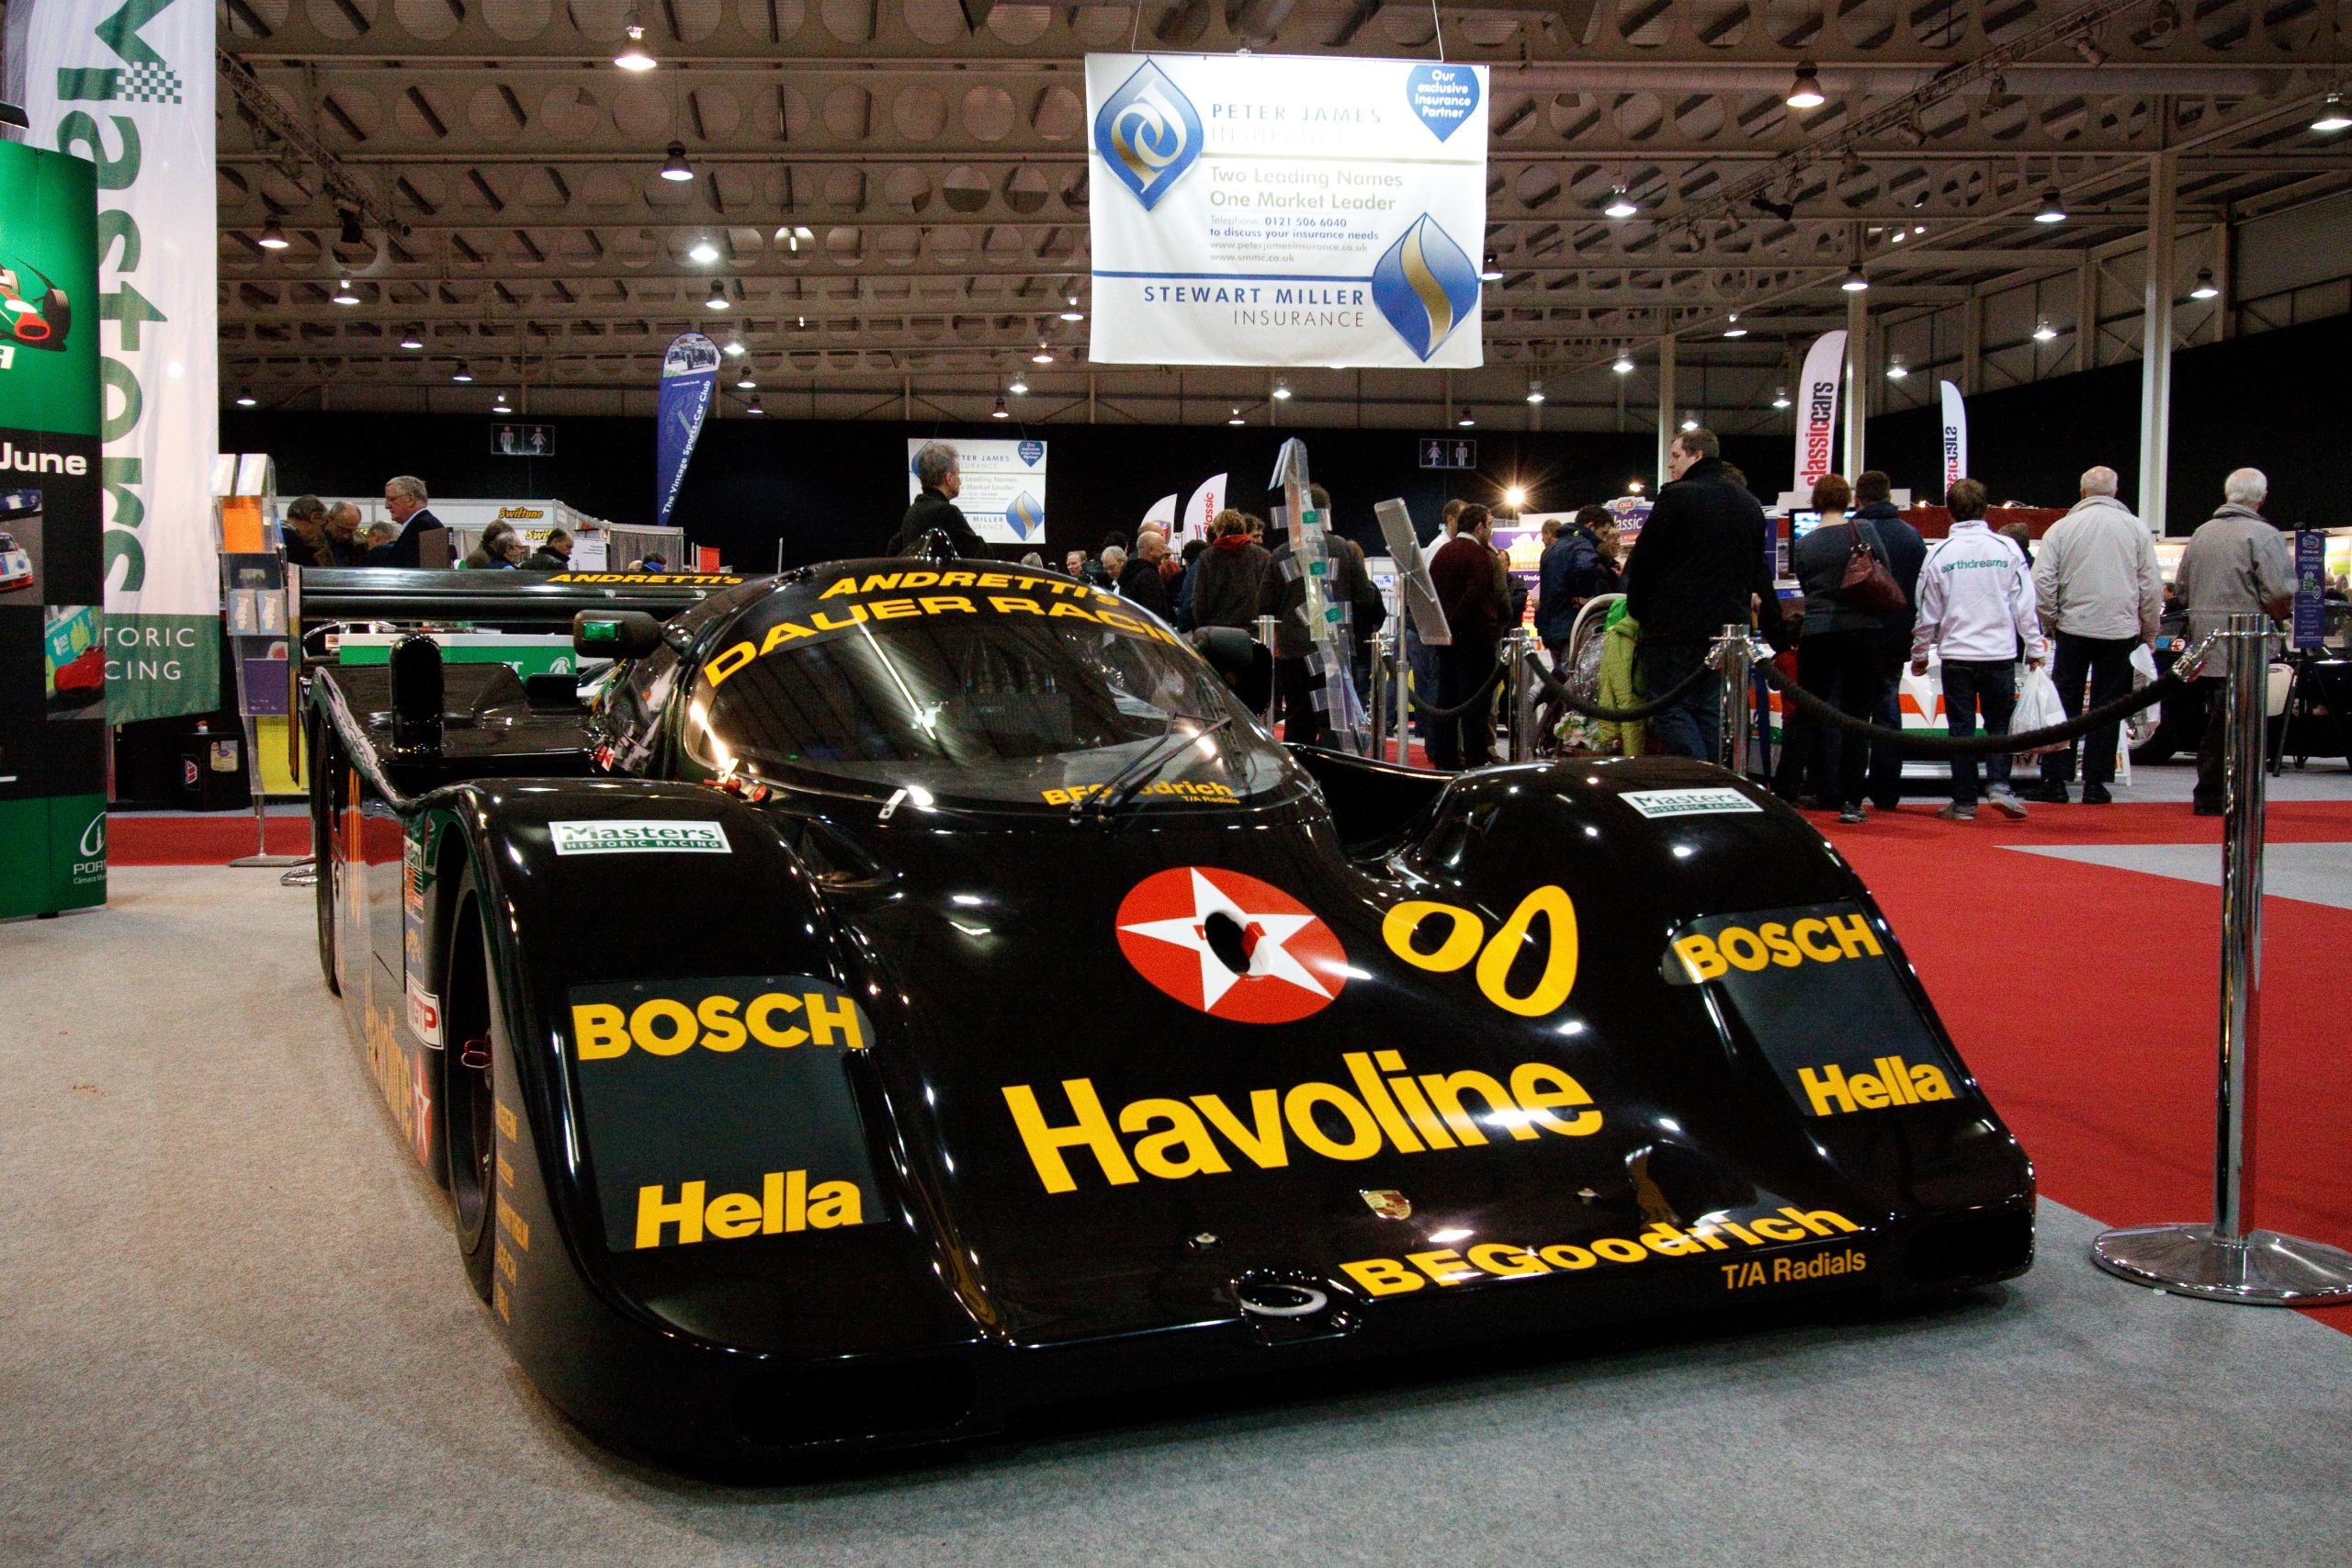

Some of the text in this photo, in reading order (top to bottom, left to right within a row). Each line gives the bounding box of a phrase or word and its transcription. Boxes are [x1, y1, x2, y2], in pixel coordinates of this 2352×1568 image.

[1431, 69, 1455, 82] Our
[1417, 82, 1469, 94] exclusive
[1415, 93, 1471, 107] Insurance
[1212, 103, 1381, 123] PETER JAMES
[1422, 106, 1464, 118] Partner
[1211, 166, 1404, 188] Two Leading Names
[1210, 190, 1396, 210] One Market Leader
[1264, 217, 1291, 227] 0121
[1296, 218, 1317, 228] 506
[1320, 219, 1347, 228] 6040
[1210, 228, 1379, 241] to discuss your insurance needs
[1144, 286, 1363, 305] STEWART MILLER
[1234, 310, 1364, 327] INSURANCE
[662, 496, 675, 514] The
[670, 458, 687, 493] Vintage
[699, 379, 711, 402] Club
[0, 442, 87, 476] June
[499, 507, 544, 519] Swiftune
[1614, 514, 1643, 531] lassic
[1940, 558, 2008, 574] earthdreams
[104, 627, 195, 648] TORIC
[703, 596, 978, 688] DAUER
[104, 660, 181, 681] CING
[1203, 797, 1240, 806] Radials
[1633, 794, 1741, 807] Masters
[561, 826, 716, 840] Masters
[566, 840, 720, 850] HISTORIC RACING
[1671, 914, 1884, 985] BOSCH
[571, 992, 865, 1061] BOSCH
[1797, 1055, 1955, 1117] Hella
[1001, 1048, 1603, 1194] Havoline
[635, 1169, 864, 1249] Hella
[1340, 1207, 1861, 1297] BFGoodrich
[1721, 1249, 1866, 1290] T/A Radials
